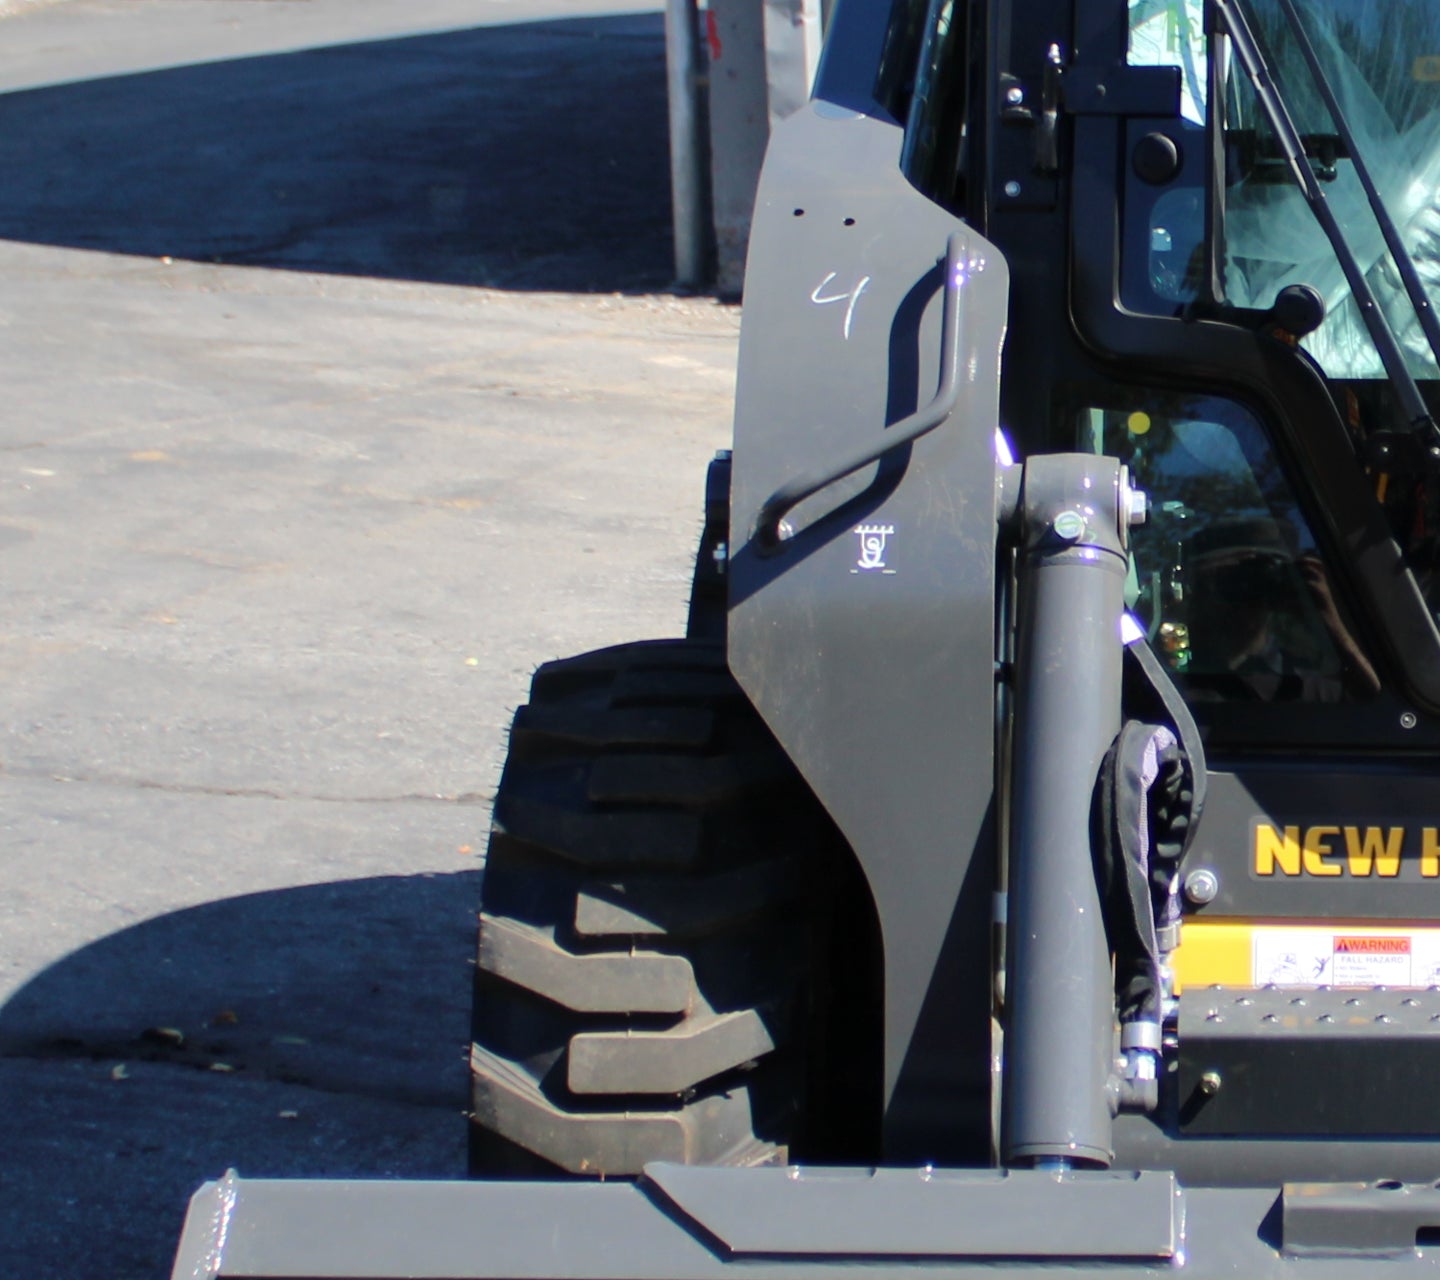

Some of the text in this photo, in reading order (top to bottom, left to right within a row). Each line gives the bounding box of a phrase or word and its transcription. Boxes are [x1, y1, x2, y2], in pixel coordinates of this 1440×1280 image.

[811, 271, 870, 341] 4
[1254, 824, 1404, 877] NEW
[1340, 956, 1404, 964] FALL HAZARD
[1347, 939, 1409, 952] WARNING
